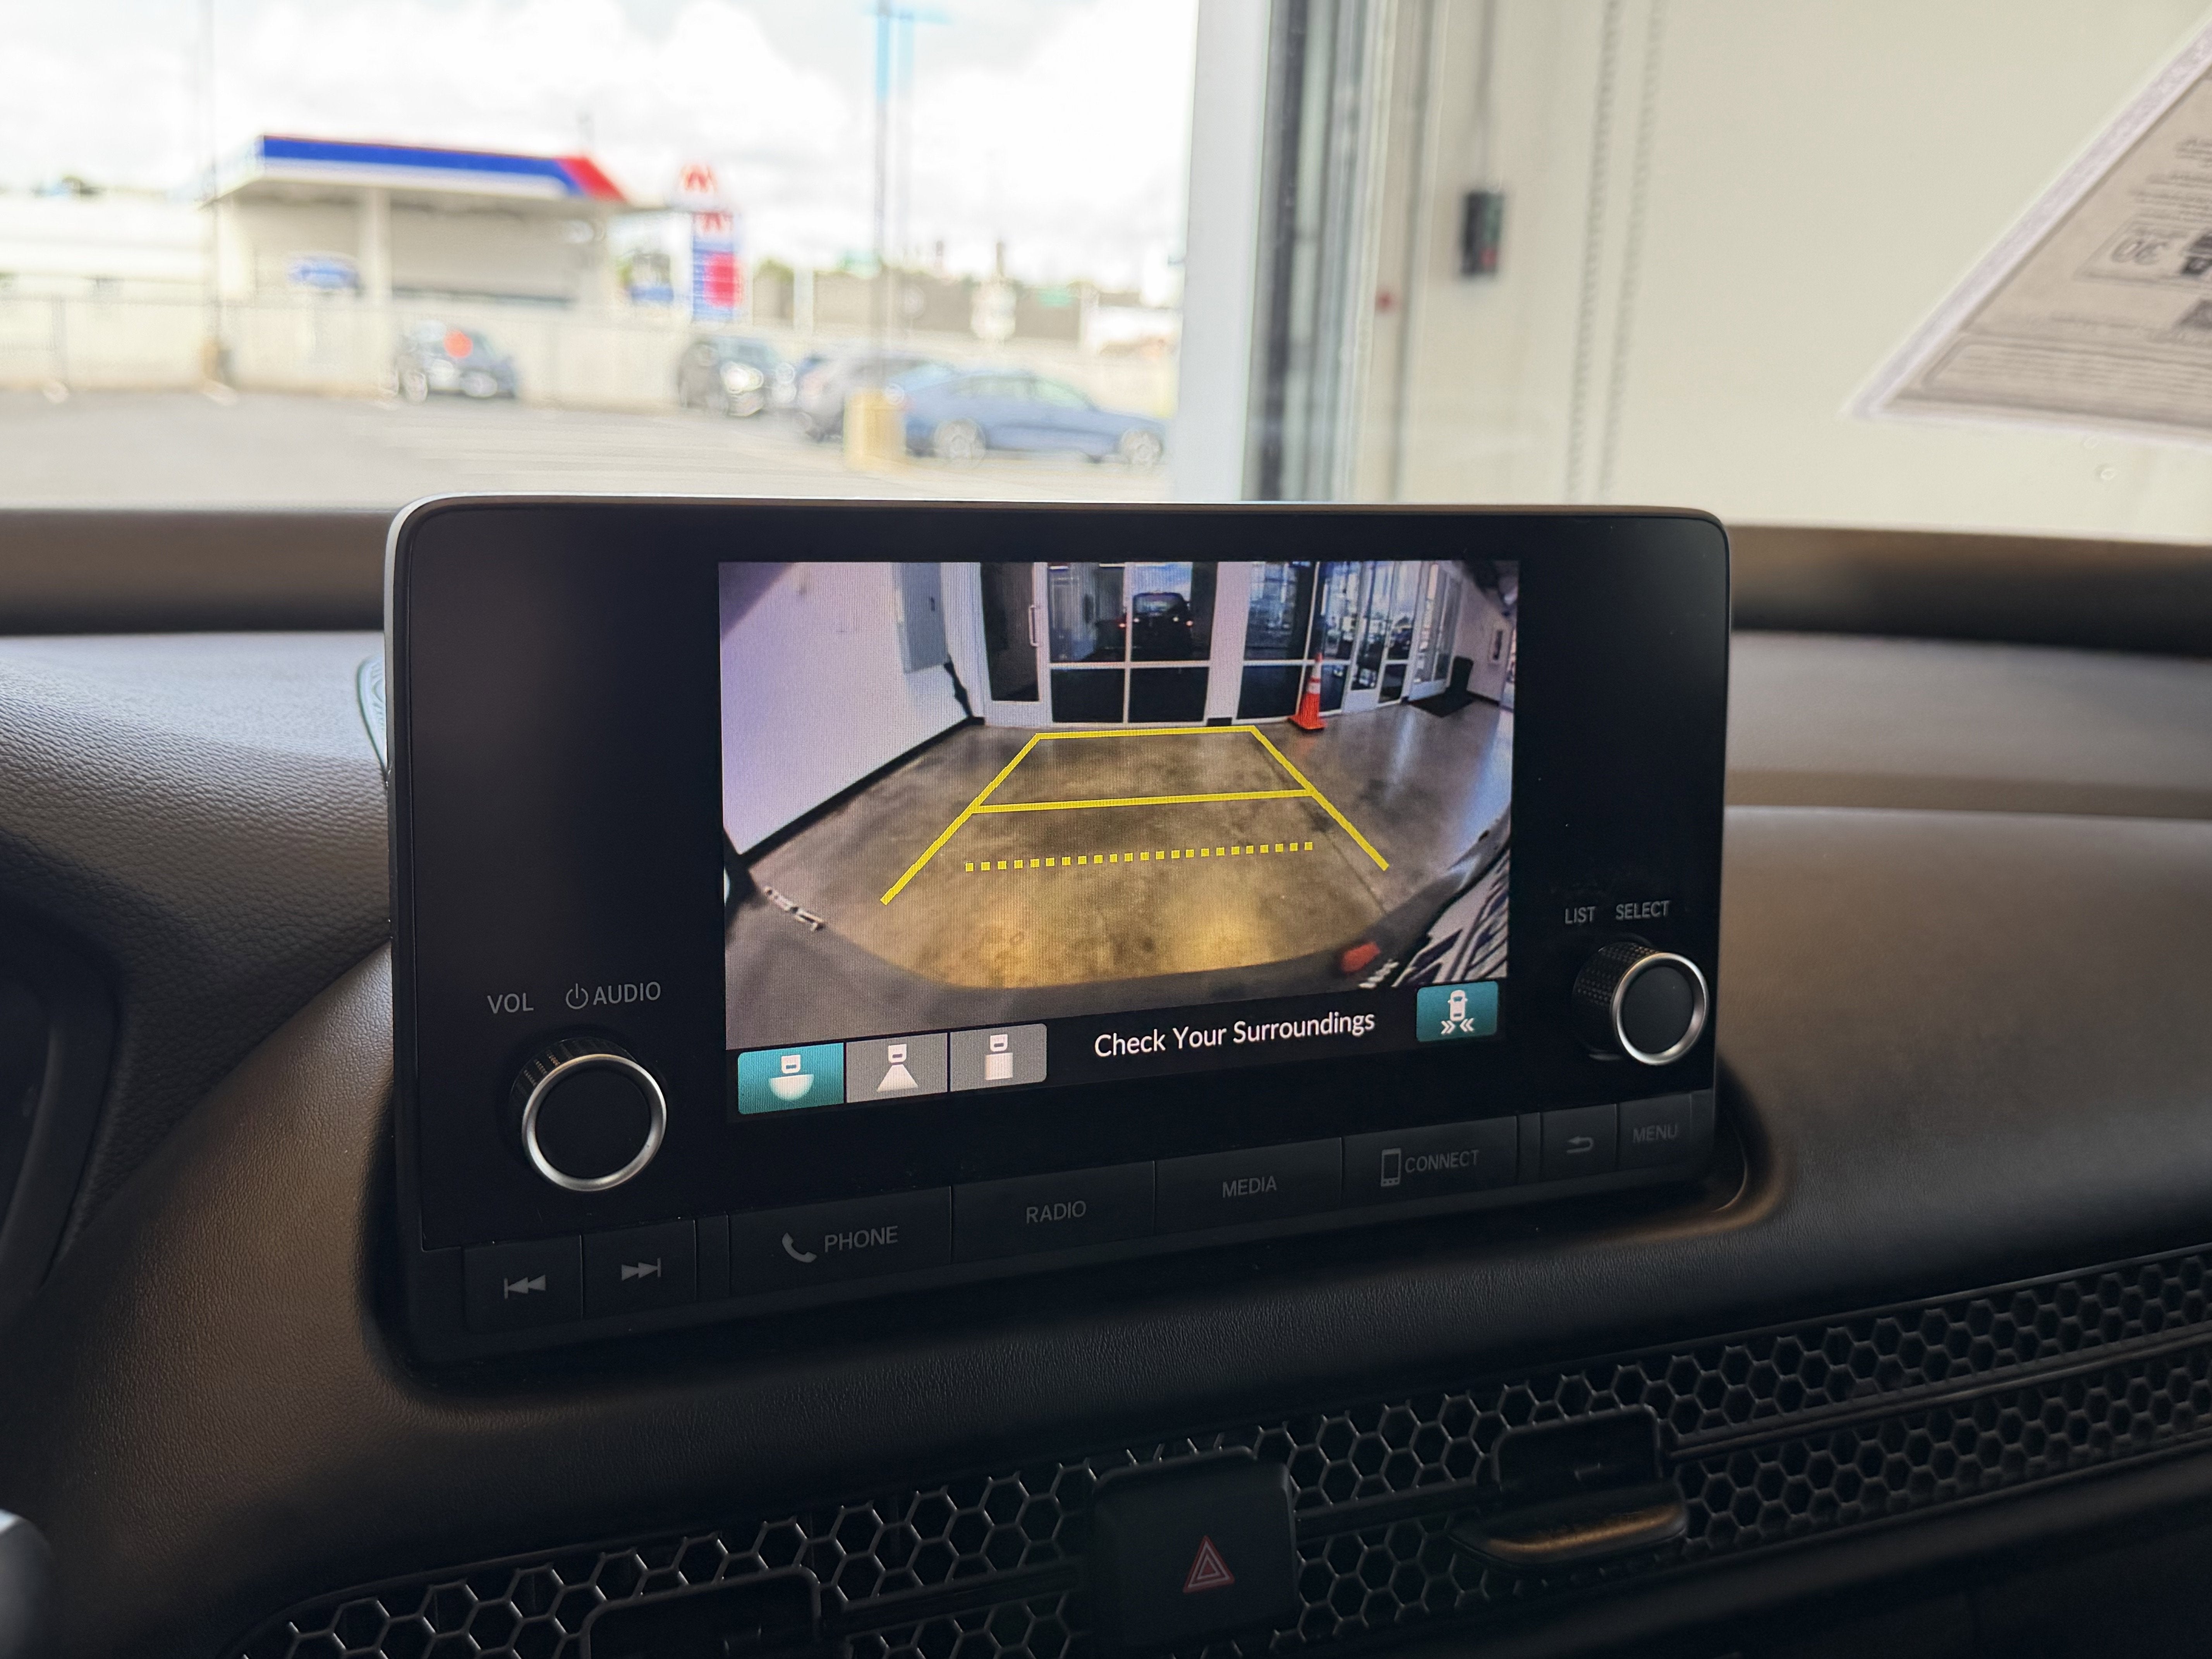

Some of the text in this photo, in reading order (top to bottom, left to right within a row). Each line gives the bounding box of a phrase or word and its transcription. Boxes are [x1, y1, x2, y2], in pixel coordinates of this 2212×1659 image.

[1565, 900, 1670, 924] LIST SELECT
[487, 992, 534, 1014] VOL
[592, 981, 661, 1006] AUDIO
[1094, 1011, 1375, 1057] Check Your Surroundings
[1632, 1124, 1678, 1144] MENU
[1404, 1149, 1480, 1174] CONNECT
[1221, 1175, 1277, 1199] MEDIA
[1025, 1200, 1087, 1224] RADIO
[824, 1225, 898, 1253] PHONE
